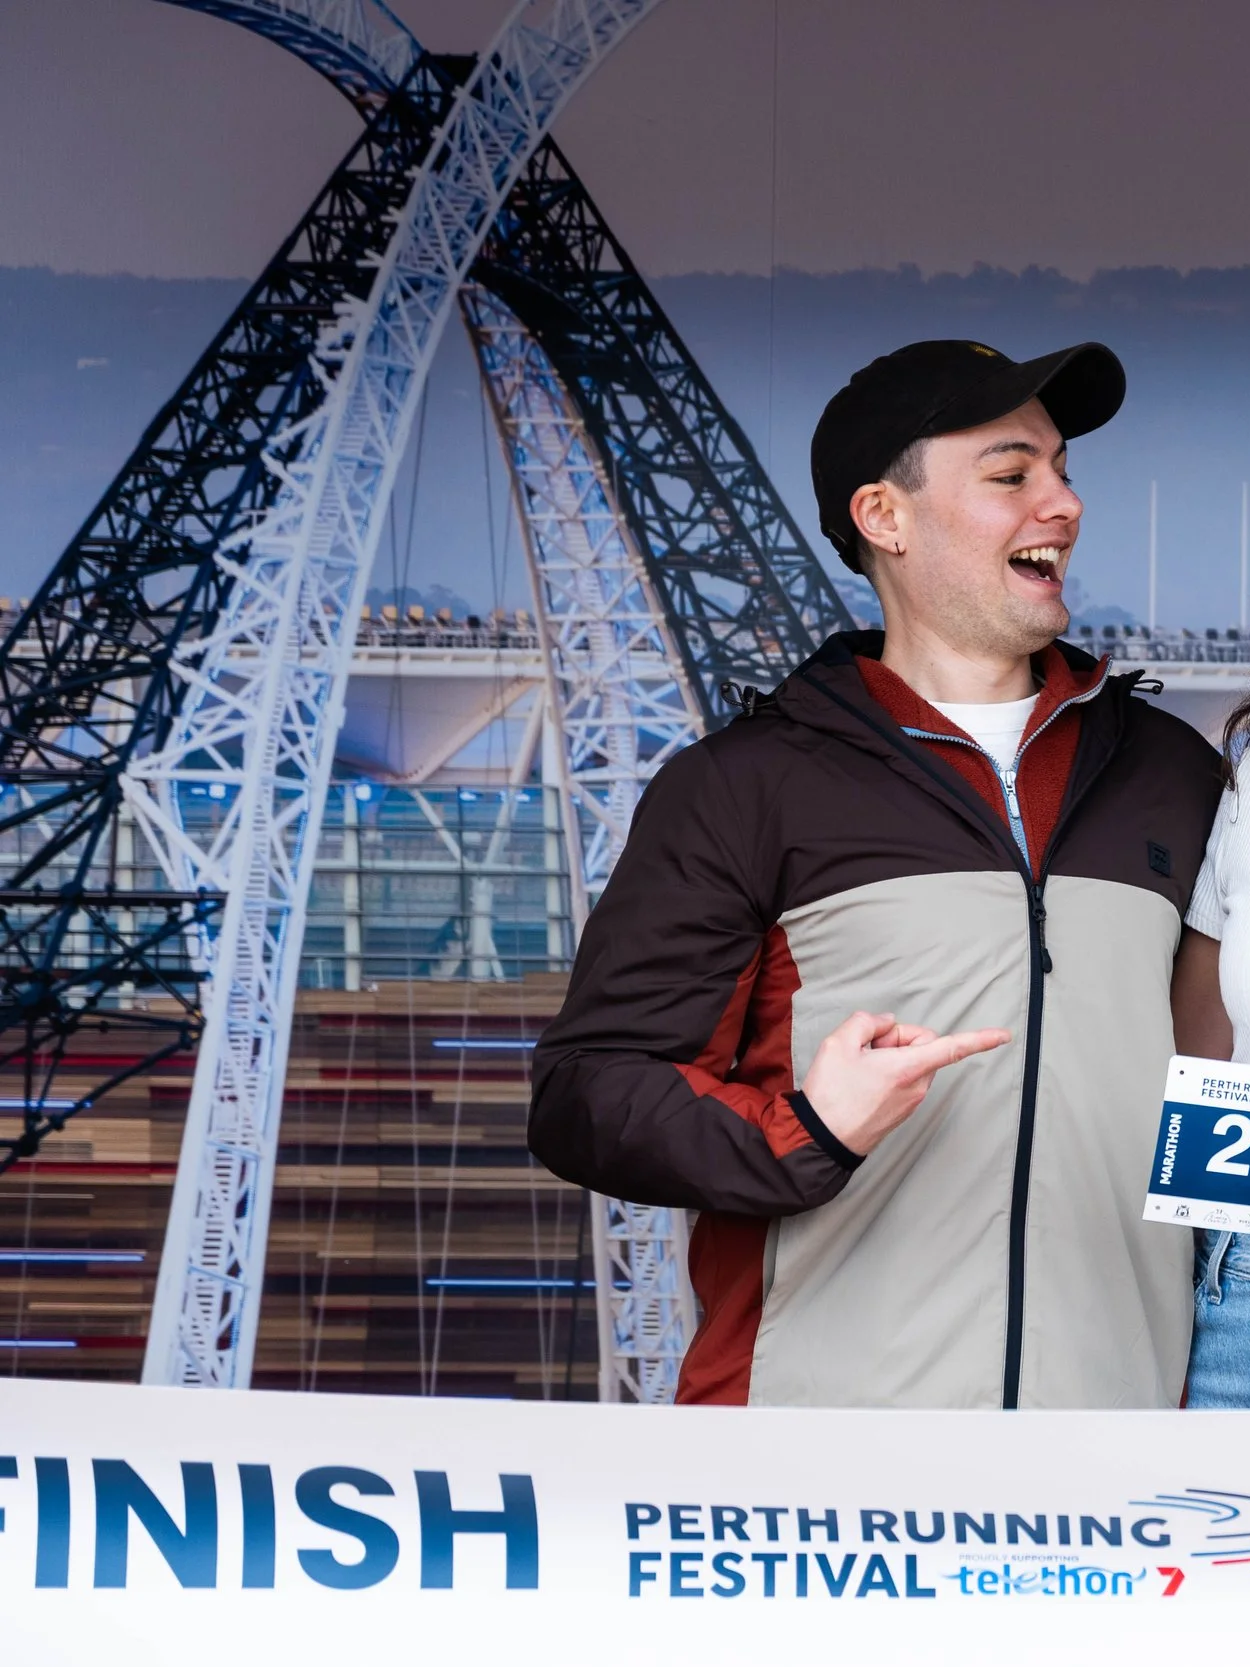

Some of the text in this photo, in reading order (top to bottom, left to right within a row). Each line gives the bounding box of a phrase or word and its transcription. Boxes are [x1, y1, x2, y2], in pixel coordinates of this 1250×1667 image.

[1203, 1078, 1241, 1091] PERTH
[1159, 1113, 1183, 1185] MARATHON
[0, 1456, 538, 1590] INISH
[625, 1503, 1171, 1547] PERTH RUNNING
[628, 1551, 936, 1598] FESTIVAL
[957, 1563, 1136, 1596] telethon
[1011, 1554, 1080, 1563] SUPPORTING
